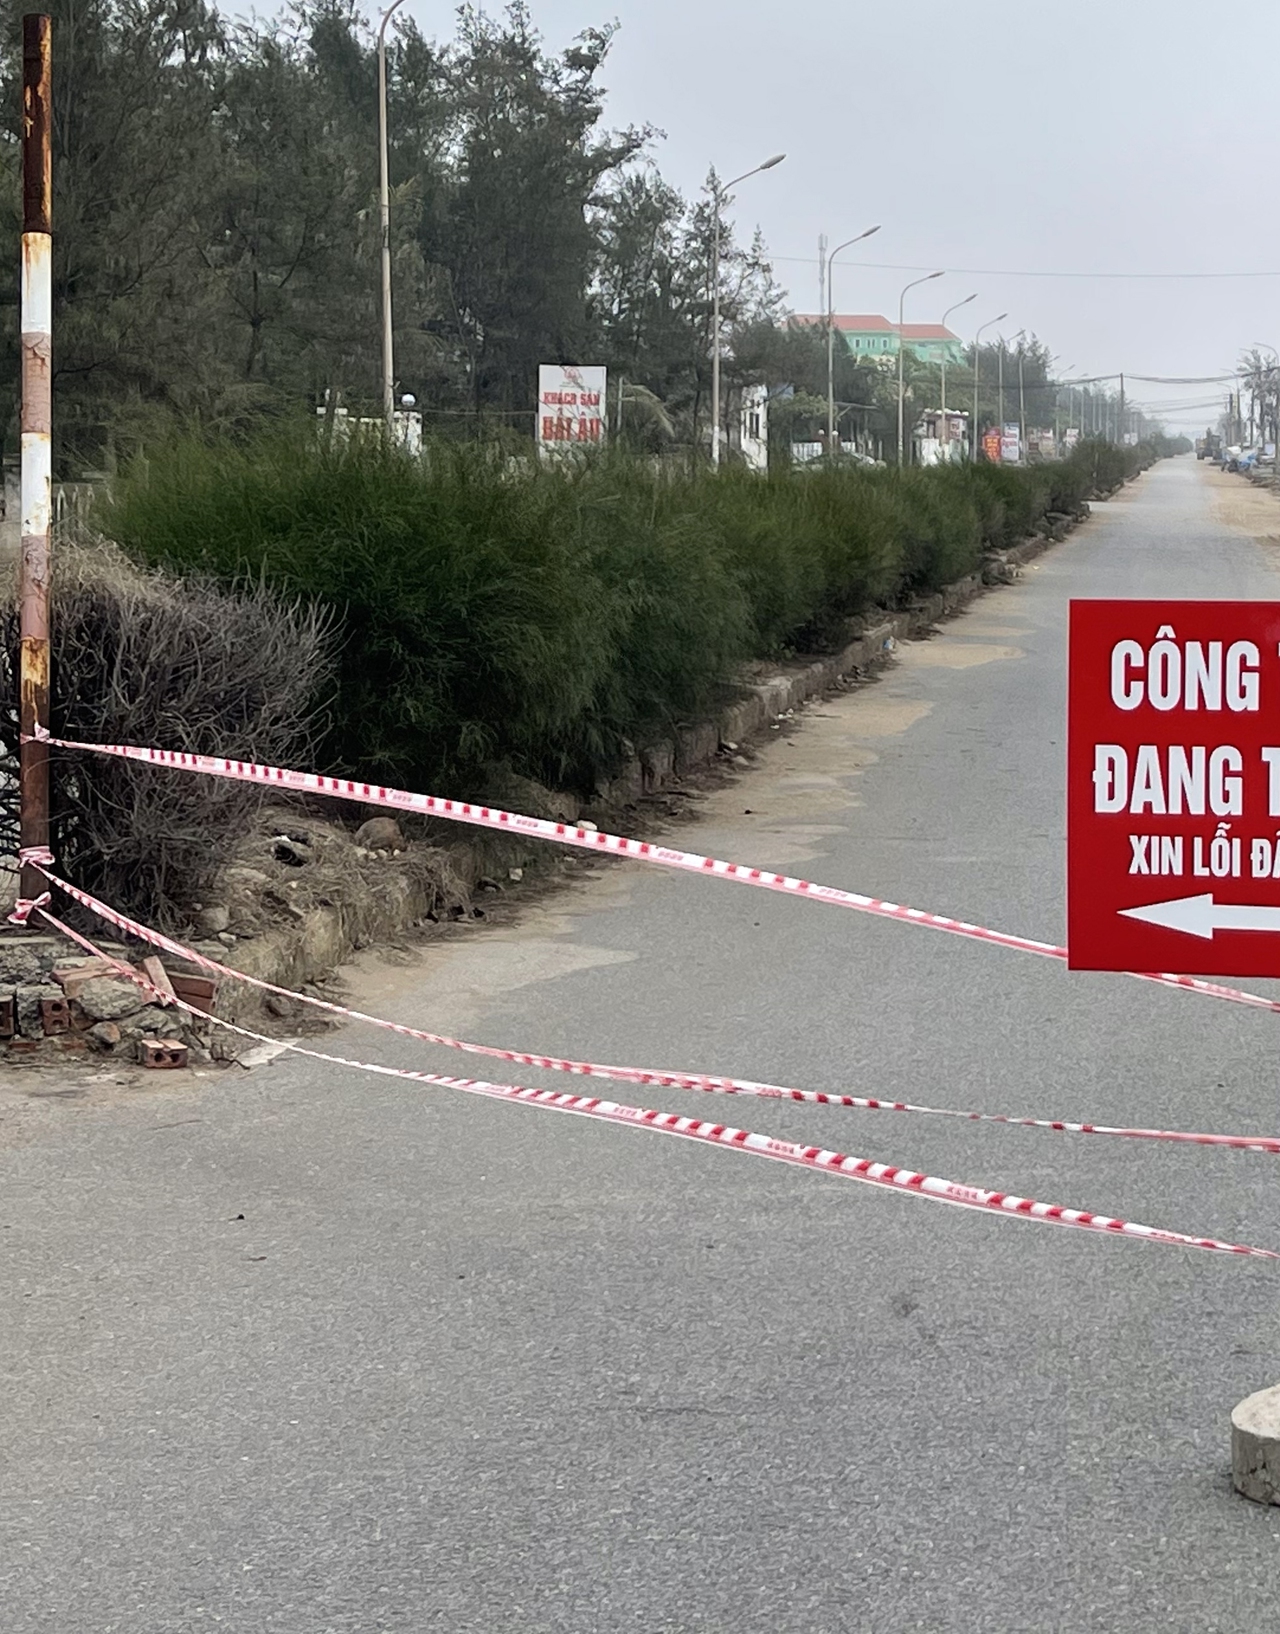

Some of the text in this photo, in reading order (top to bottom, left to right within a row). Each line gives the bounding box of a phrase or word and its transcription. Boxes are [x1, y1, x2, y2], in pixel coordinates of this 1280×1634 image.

[1111, 625, 1261, 712] CÔNG
[1092, 744, 1243, 817] ĐANG
[1128, 834, 1184, 876] XIN
[1193, 822, 1241, 878] LỖI
